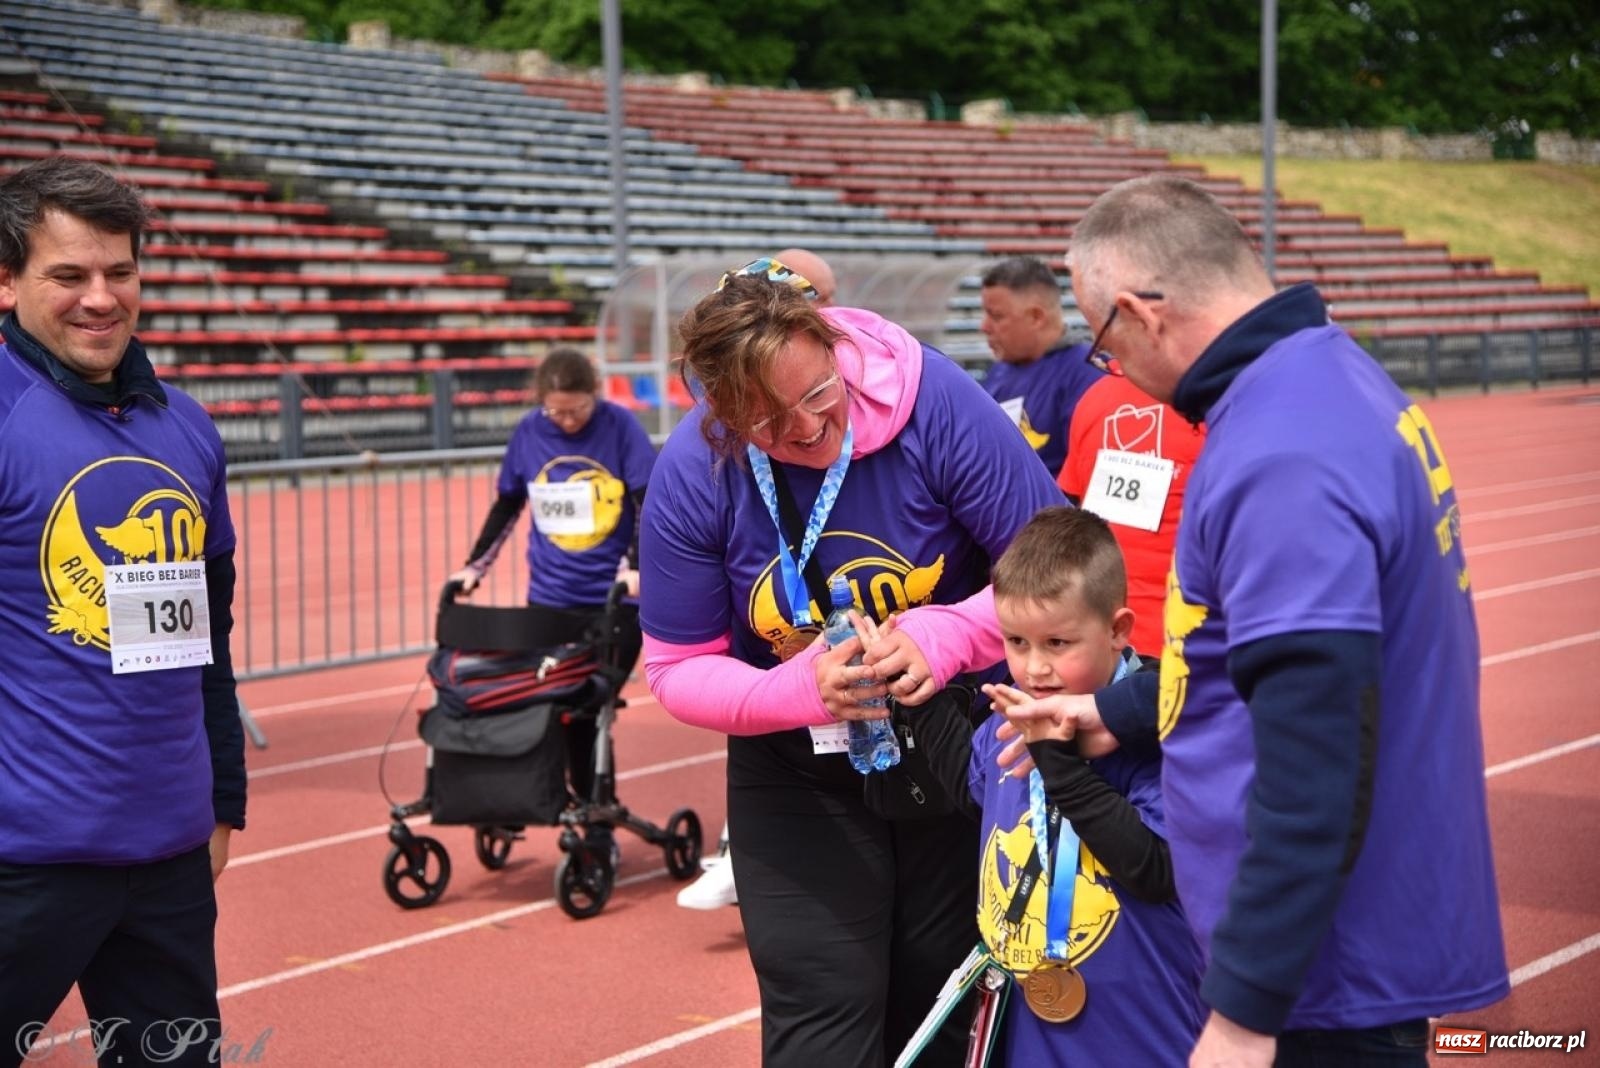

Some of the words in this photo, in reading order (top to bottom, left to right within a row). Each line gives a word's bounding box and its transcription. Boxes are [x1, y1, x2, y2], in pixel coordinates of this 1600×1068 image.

[1105, 475, 1141, 501] 128
[115, 572, 124, 584] X
[127, 571, 155, 583] BIEG
[158, 569, 176, 581] BEZ
[179, 567, 201, 580] BARIER
[144, 598, 194, 634] 130
[1013, 948, 1033, 963] BEZ
